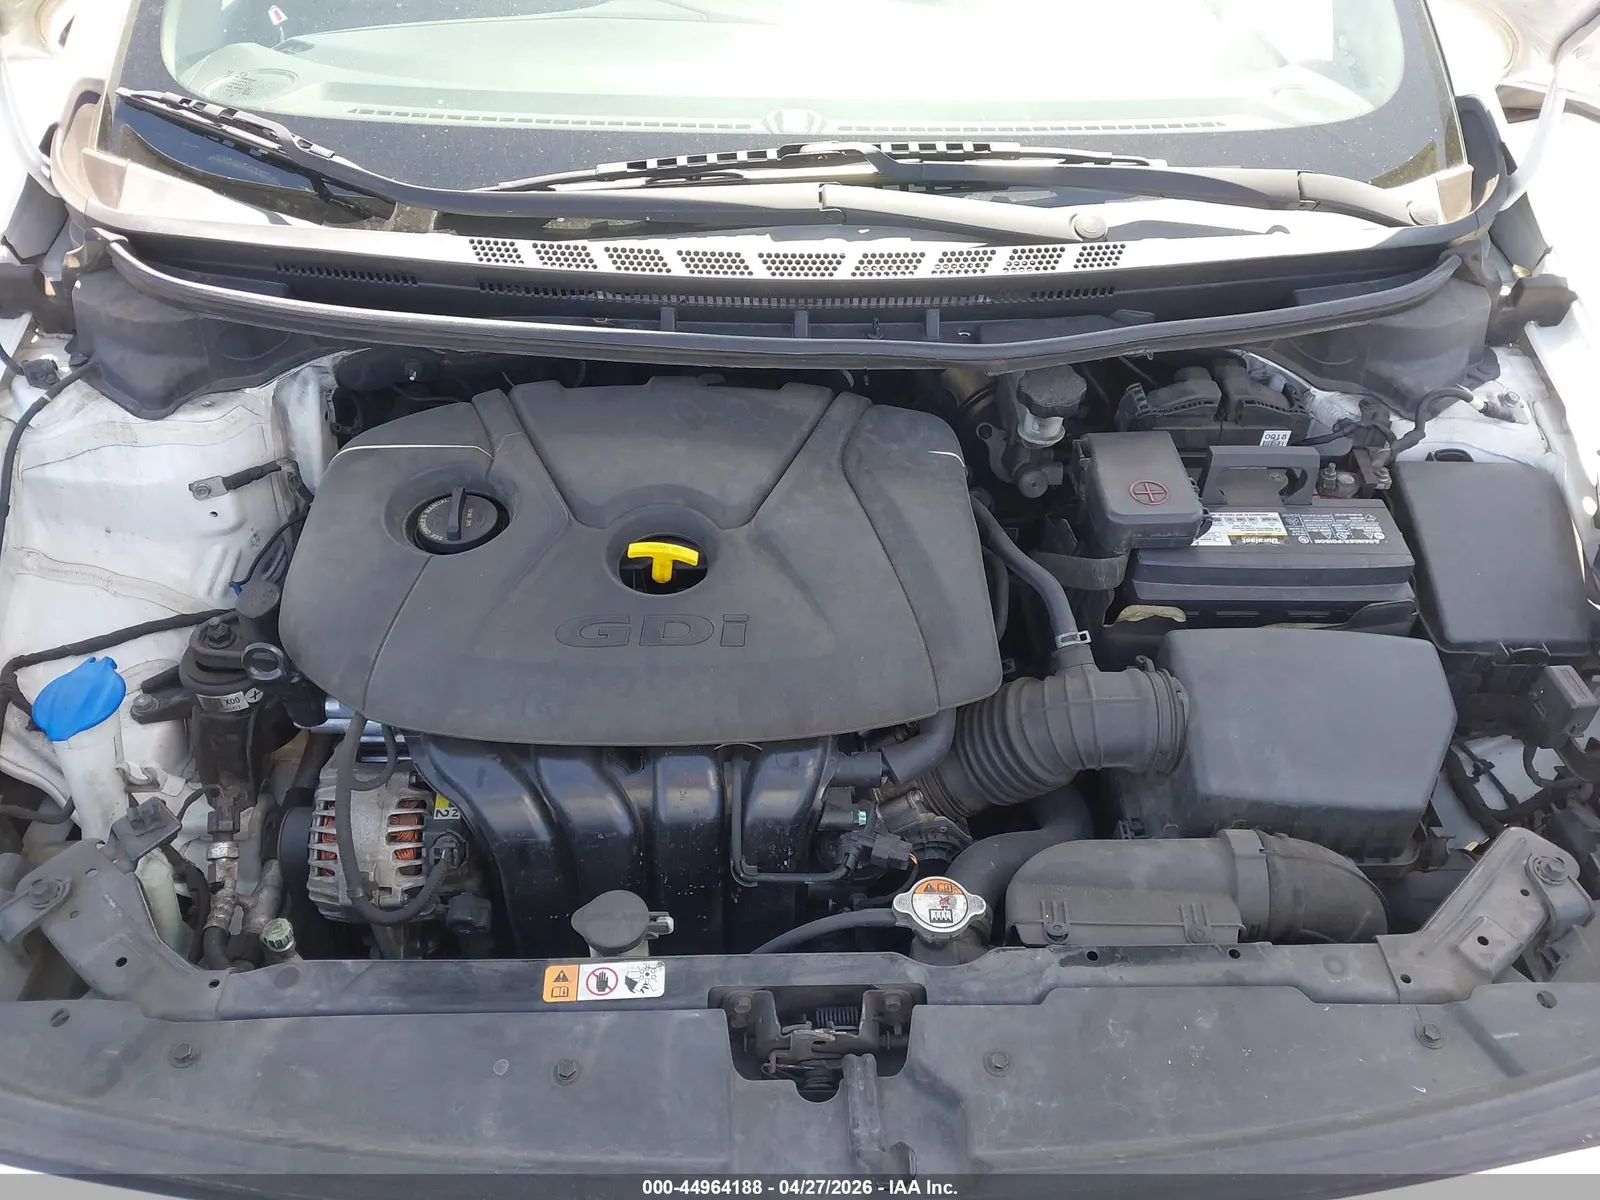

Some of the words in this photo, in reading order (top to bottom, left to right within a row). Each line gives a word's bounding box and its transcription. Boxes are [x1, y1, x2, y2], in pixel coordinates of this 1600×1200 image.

[424, 498, 451, 514] MANUAL
[429, 533, 444, 541] SEE
[1241, 537, 1281, 545] Duralast
[555, 613, 749, 648] GDi
